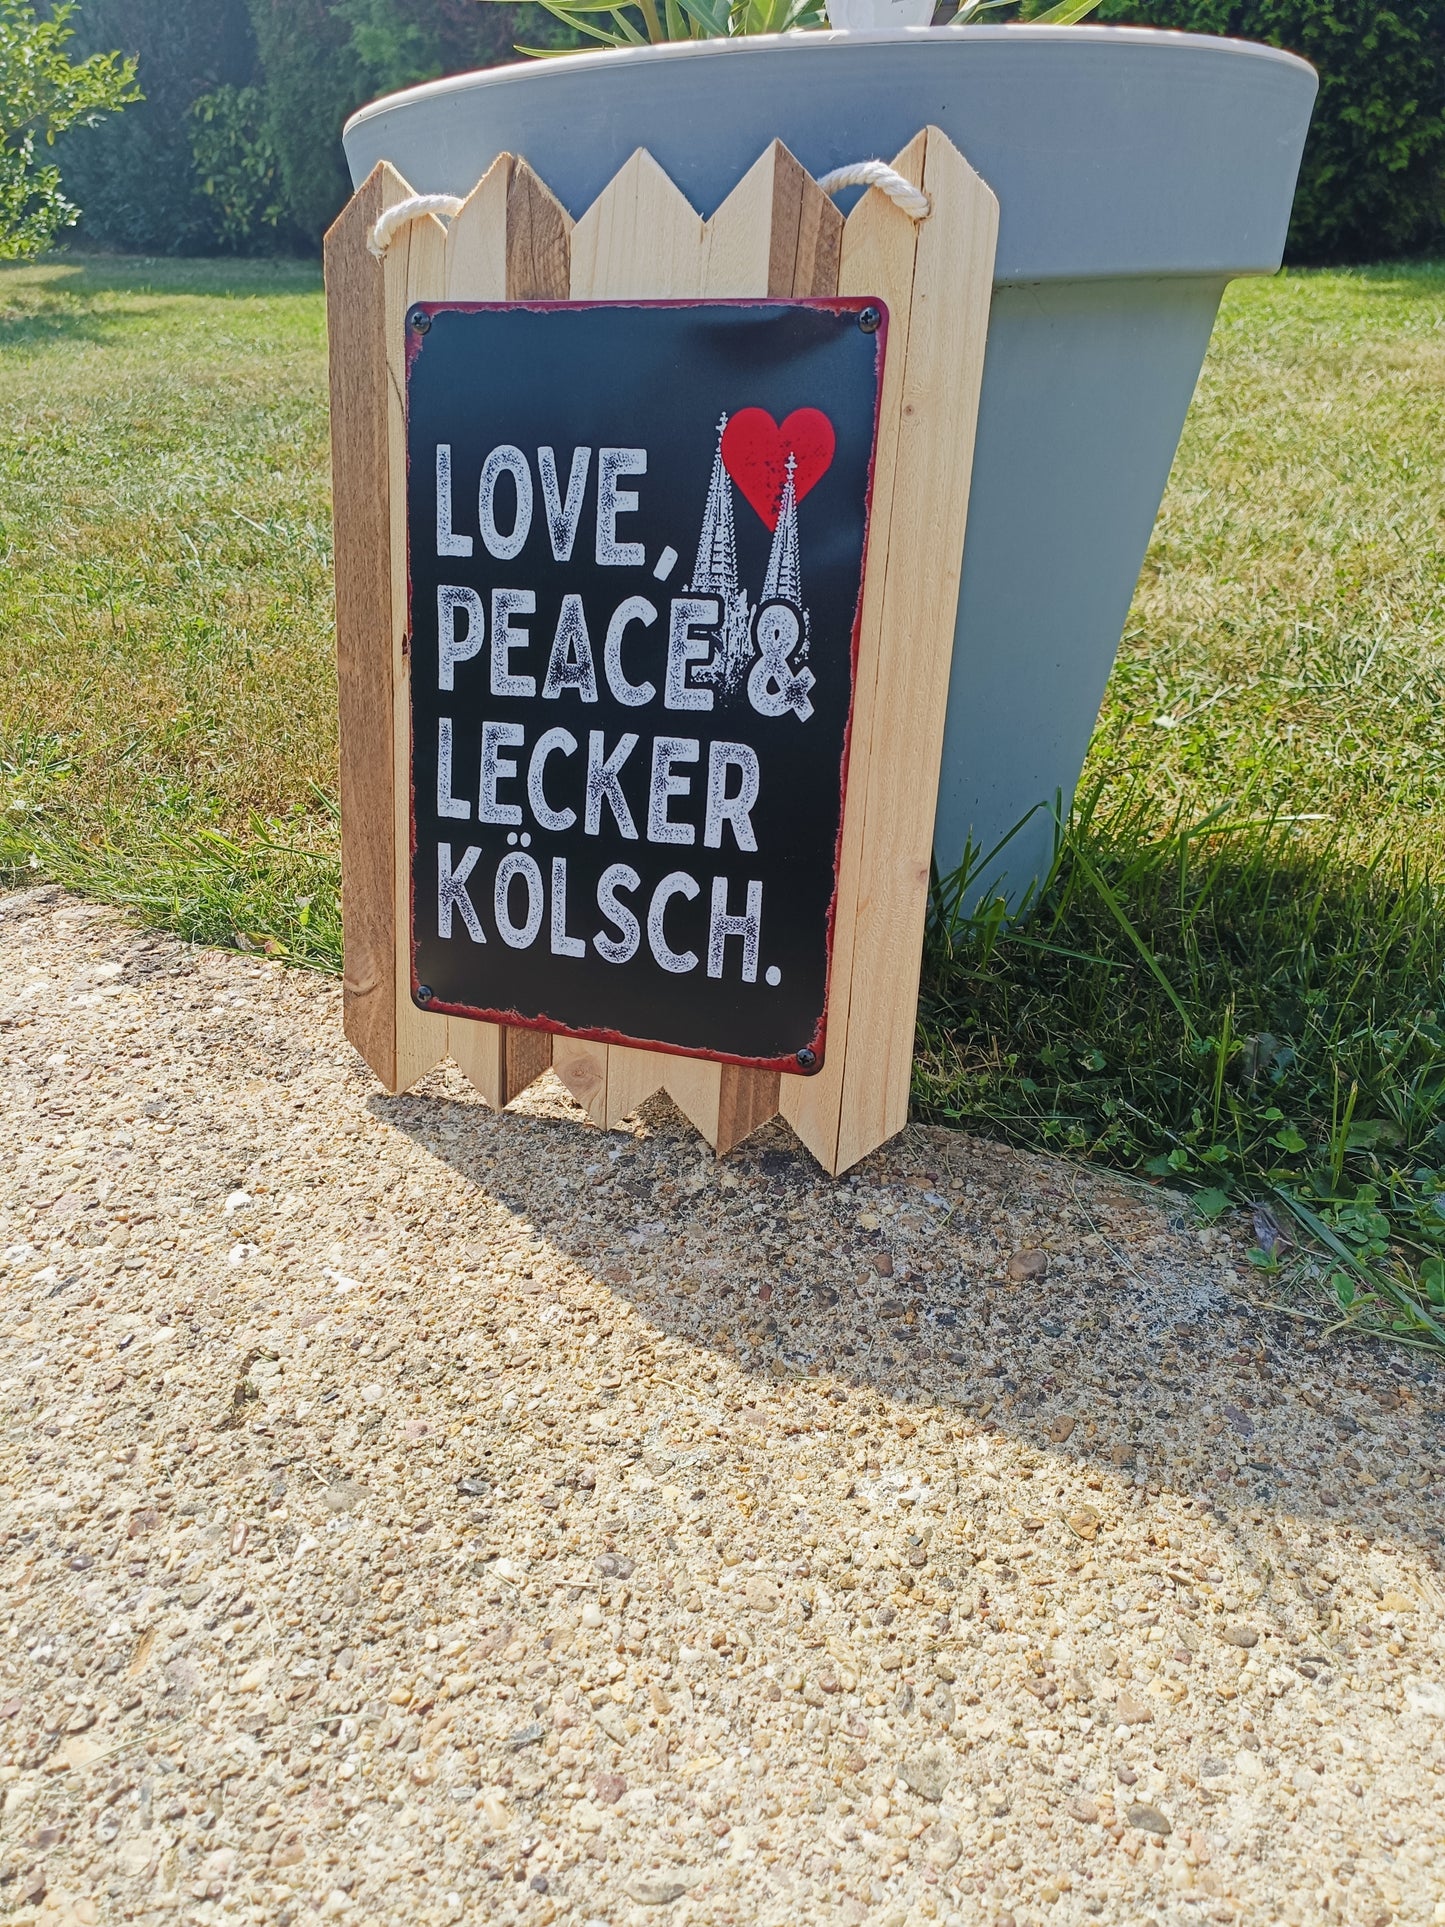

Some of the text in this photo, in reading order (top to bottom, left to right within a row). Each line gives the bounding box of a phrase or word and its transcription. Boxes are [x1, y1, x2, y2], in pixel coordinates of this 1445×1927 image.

[436, 444, 679, 581] LOVE,
[437, 585, 817, 722] PEACE &
[436, 717, 759, 852] LECKER
[437, 832, 782, 986] KÖLSCH.
